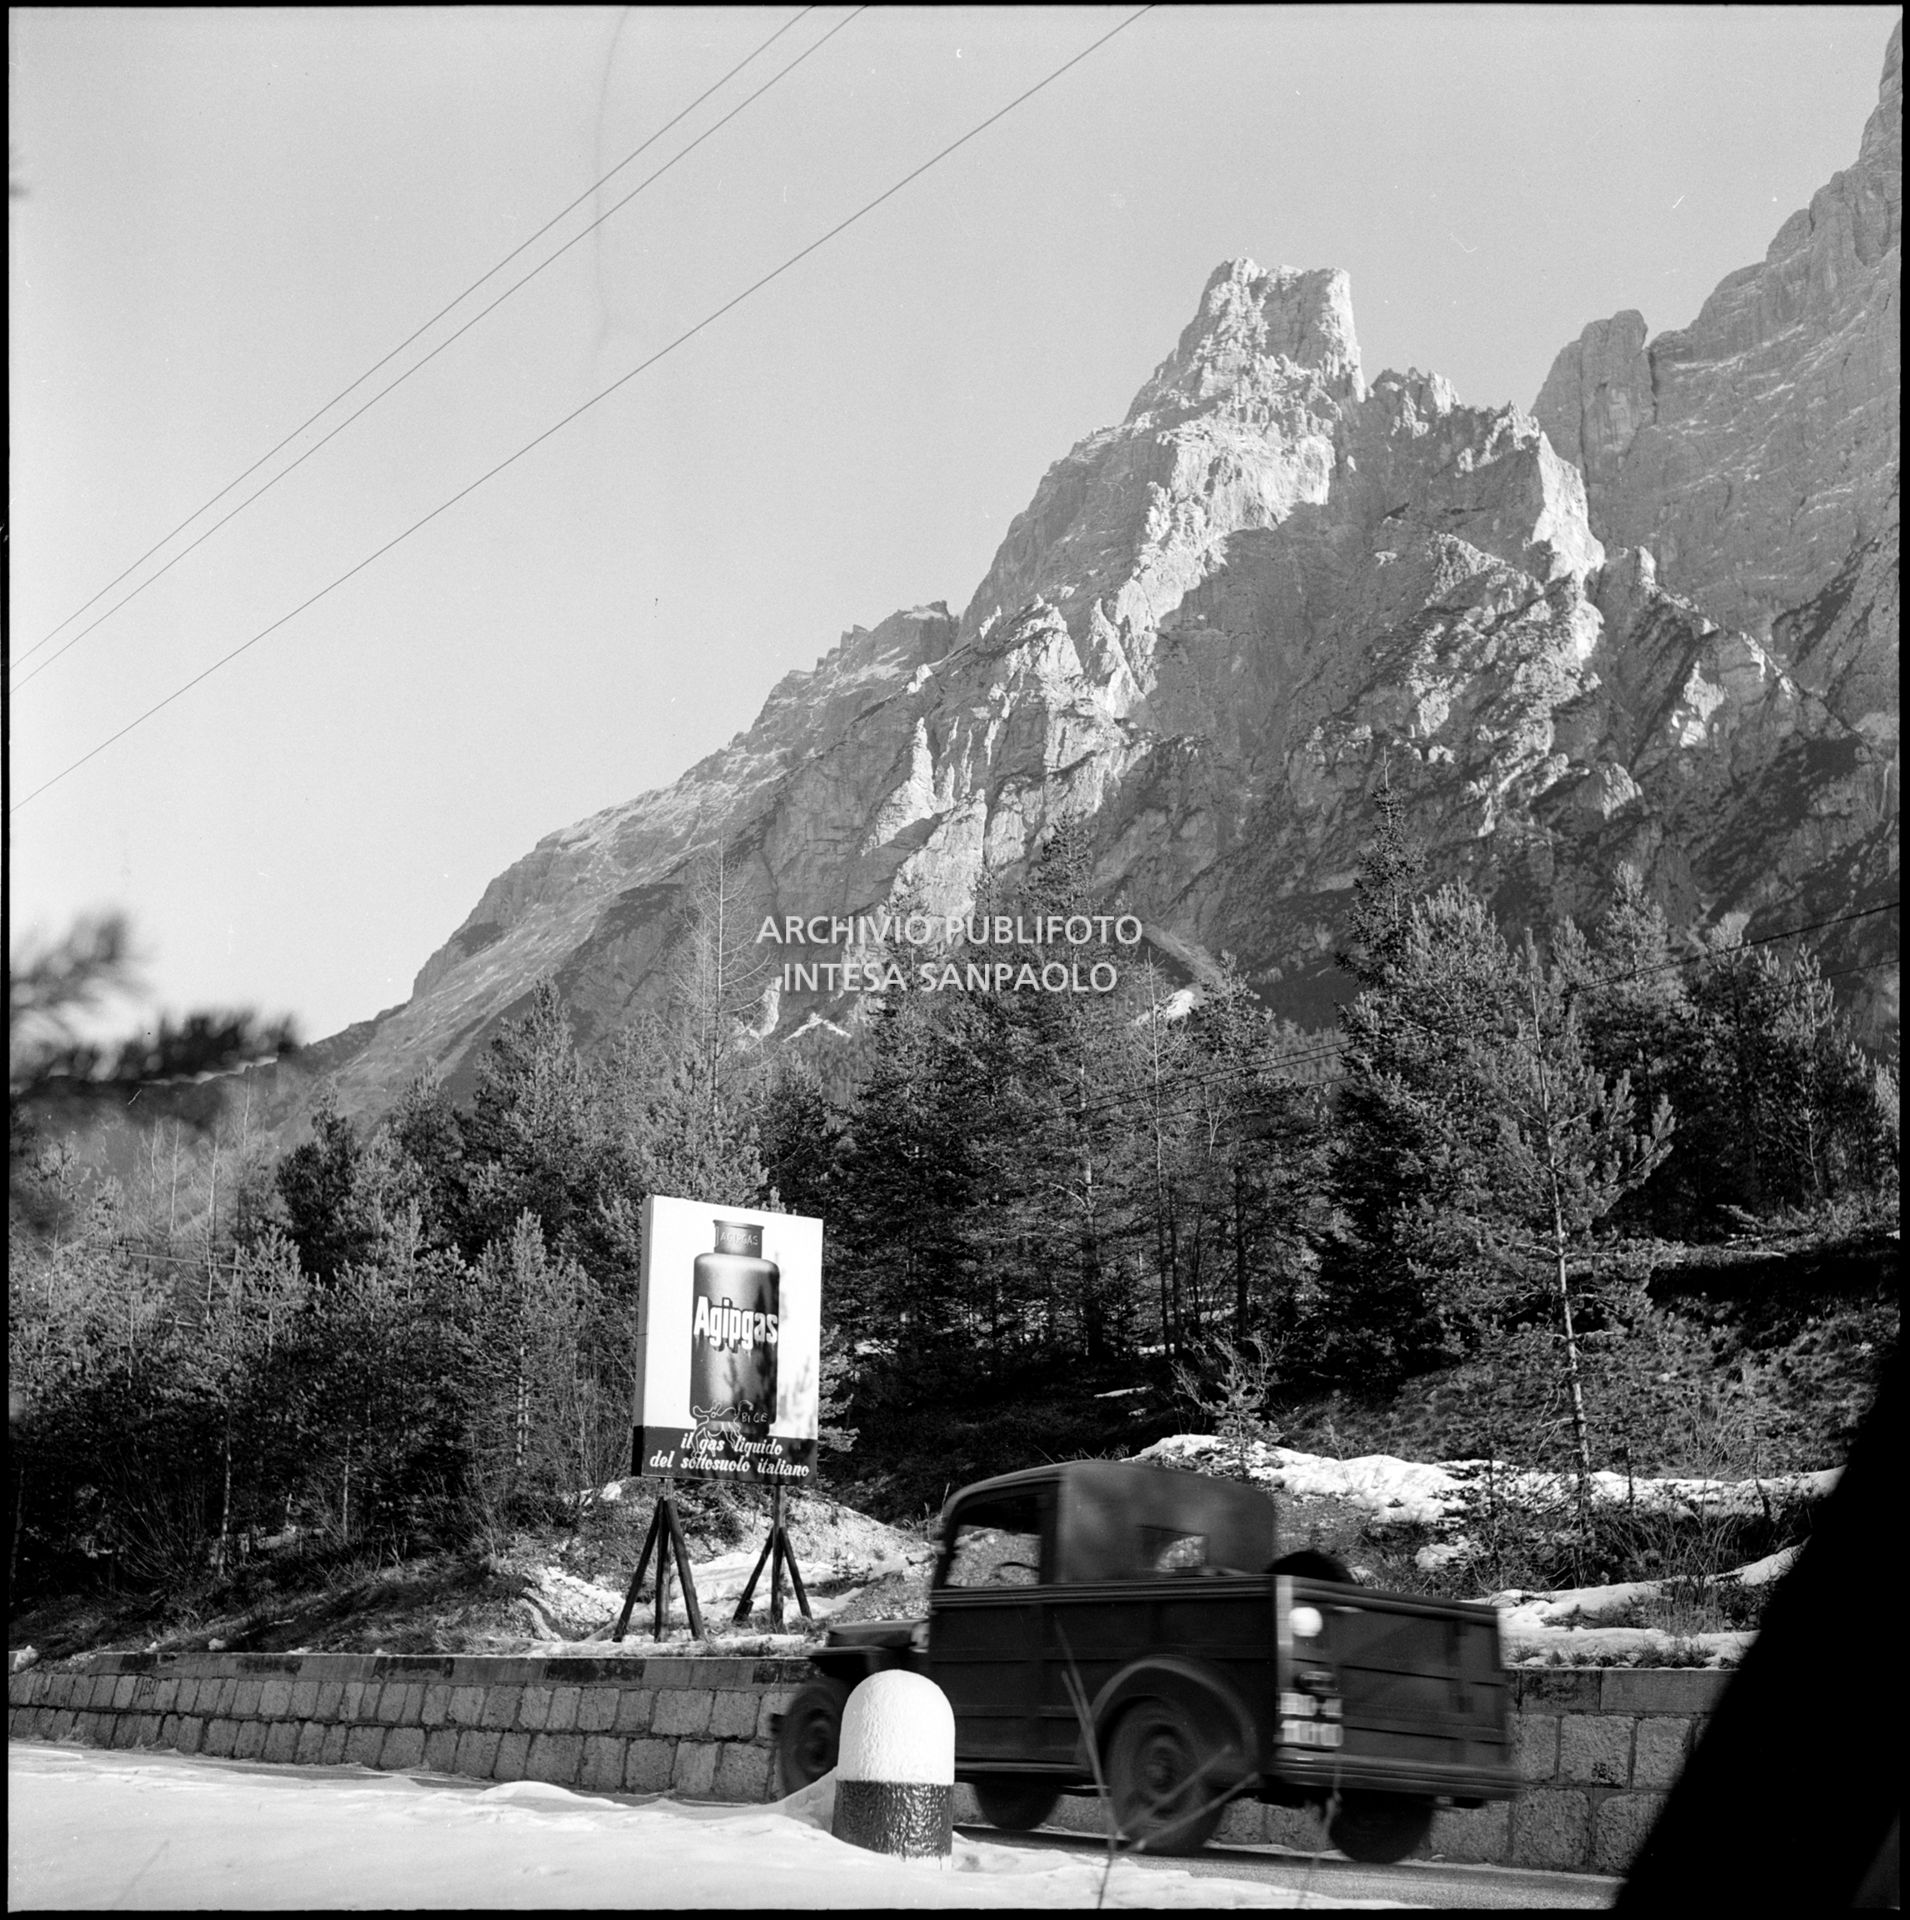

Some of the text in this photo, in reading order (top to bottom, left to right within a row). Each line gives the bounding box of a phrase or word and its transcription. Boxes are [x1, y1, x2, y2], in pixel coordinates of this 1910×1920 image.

[720, 1231, 759, 1246] AGIPGAS
[693, 1295, 778, 1350] Agipgas
[680, 1432, 783, 1457] il gas liquido
[650, 1450, 809, 1477] del sottosuolo italiano
